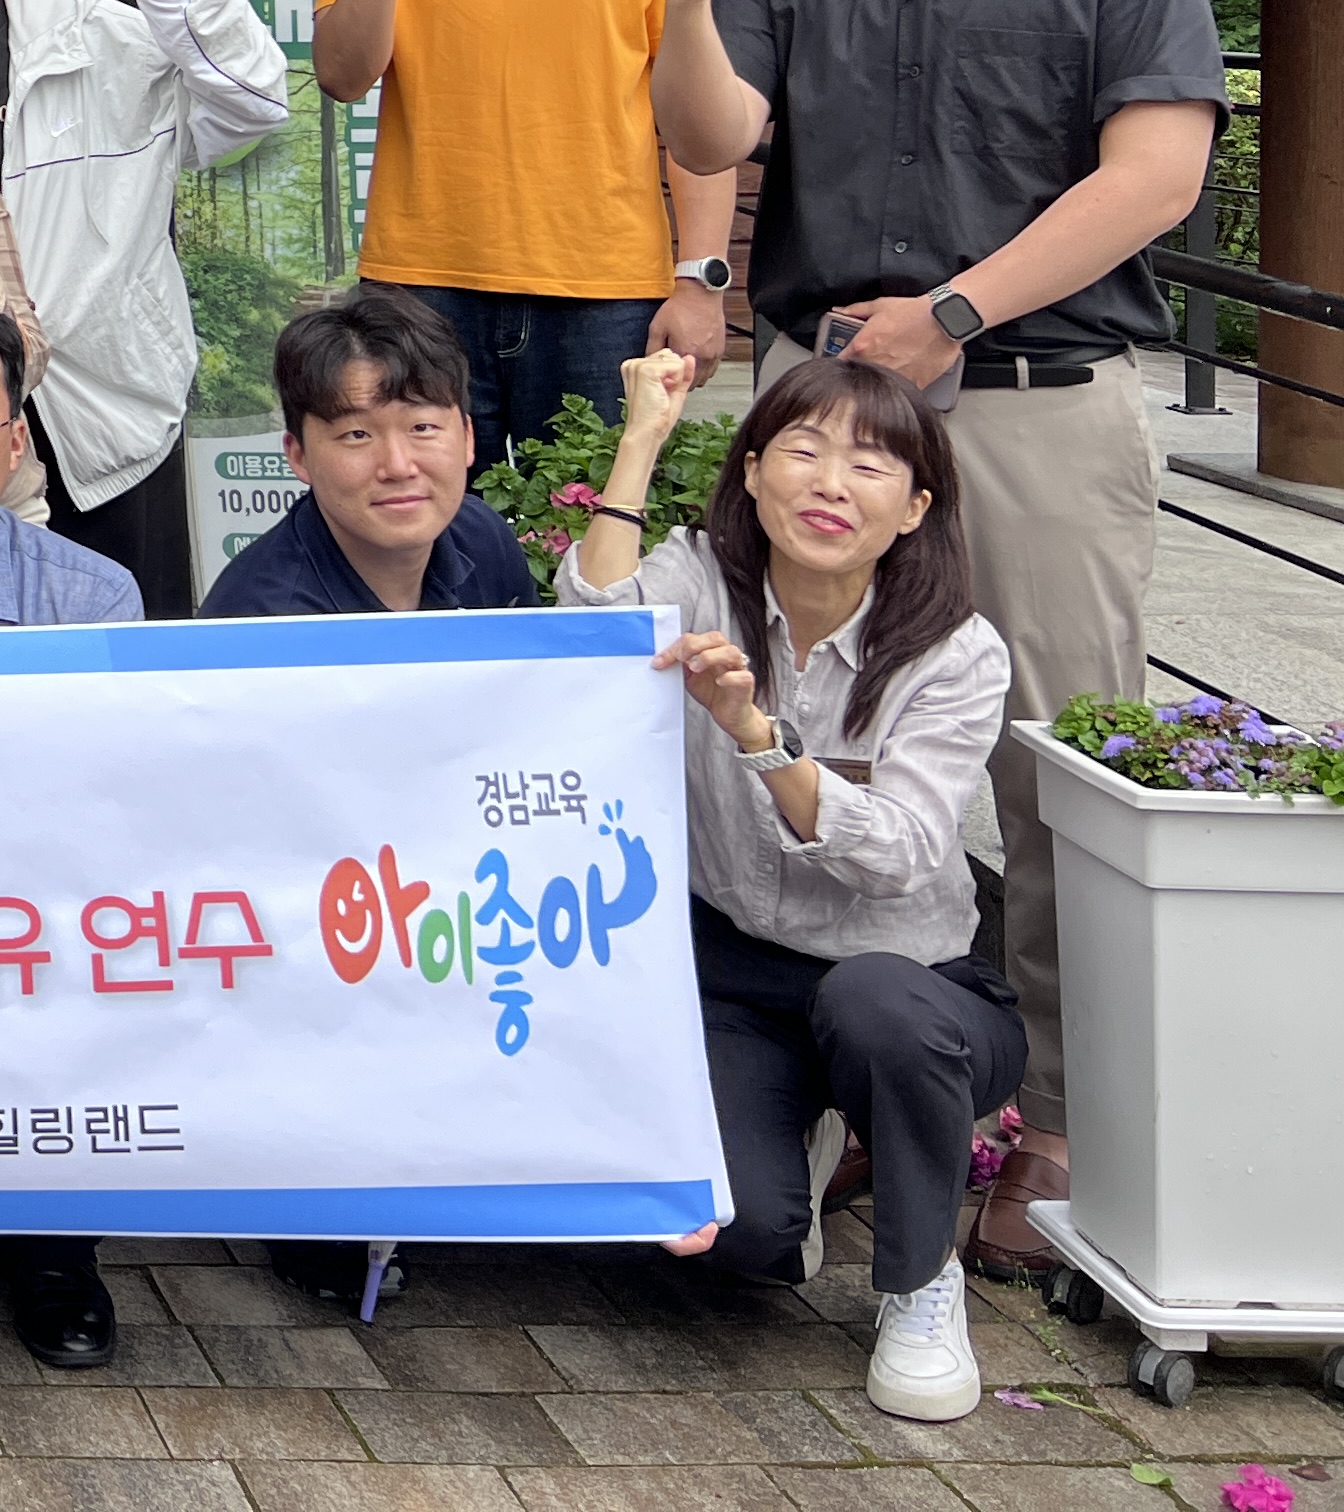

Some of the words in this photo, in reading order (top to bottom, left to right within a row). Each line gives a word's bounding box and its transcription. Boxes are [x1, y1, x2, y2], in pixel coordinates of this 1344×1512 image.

[218, 489, 308, 516] 10,000
[476, 771, 587, 827] 경남교육
[81, 891, 273, 993] 연수
[319, 828, 658, 1056] 아이좋아
